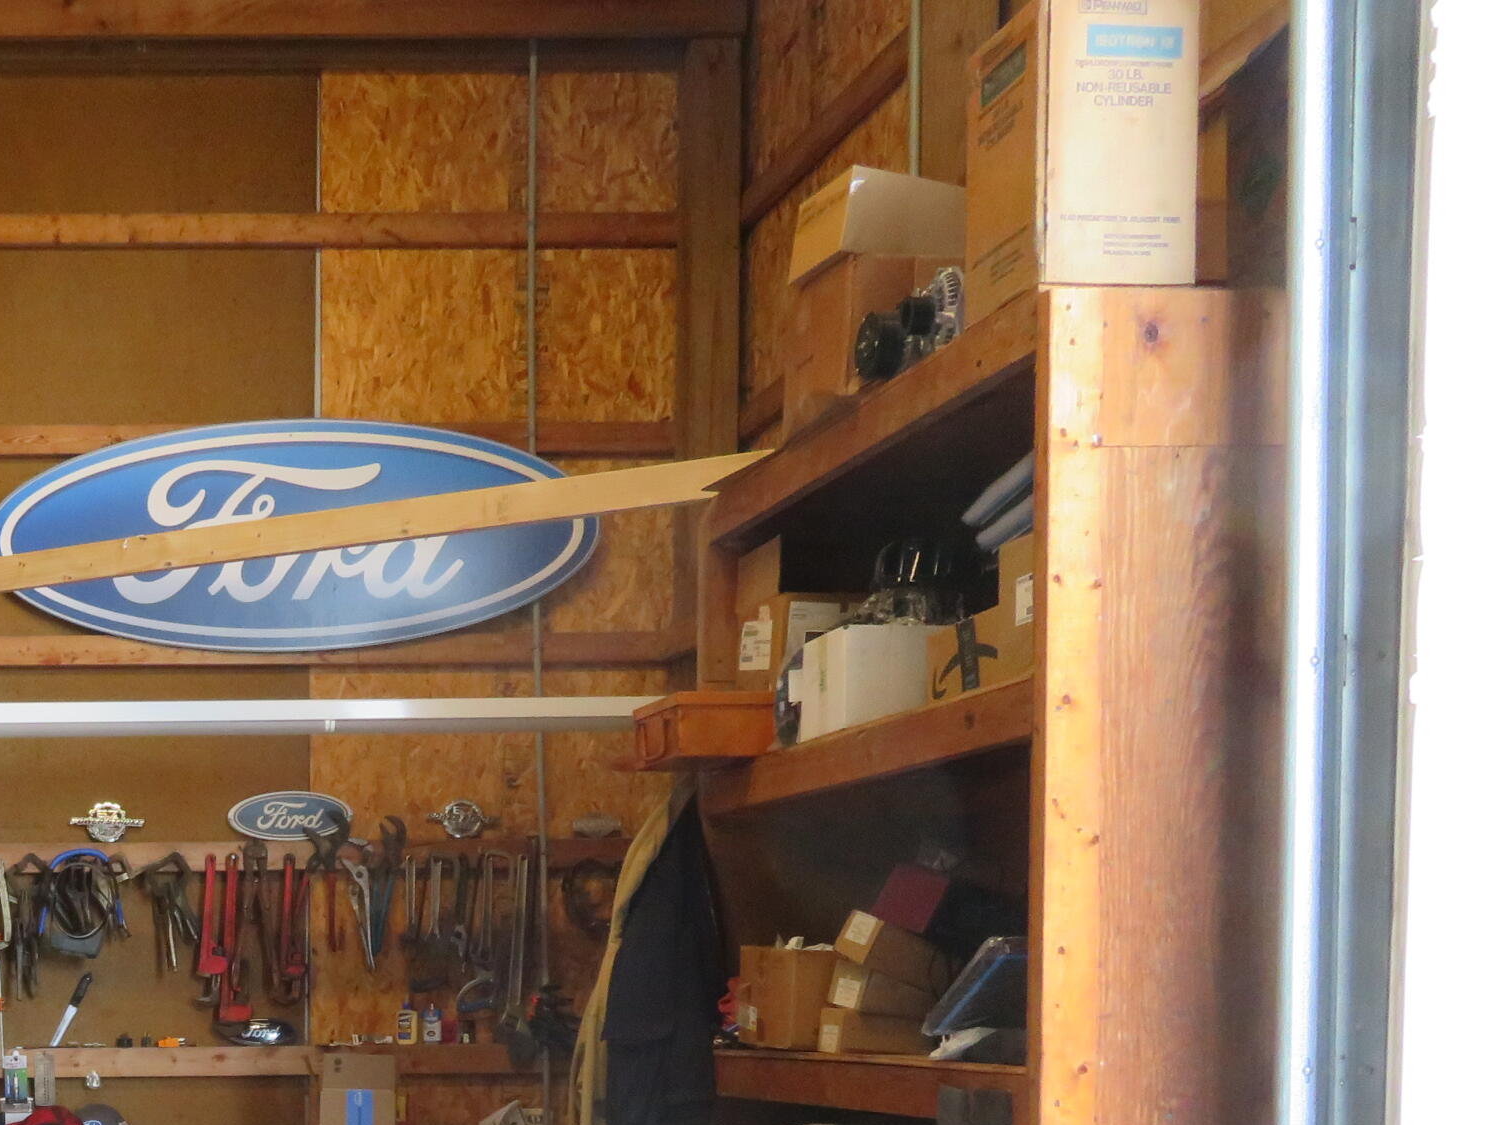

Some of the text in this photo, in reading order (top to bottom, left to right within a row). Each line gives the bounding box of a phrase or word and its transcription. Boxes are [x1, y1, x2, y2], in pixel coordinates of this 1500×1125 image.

[1108, 69, 1124, 80] 30
[1076, 81, 1172, 94] NON-REUSABLE
[1093, 94, 1155, 107] CYLINDER
[256, 801, 324, 830] Ford
